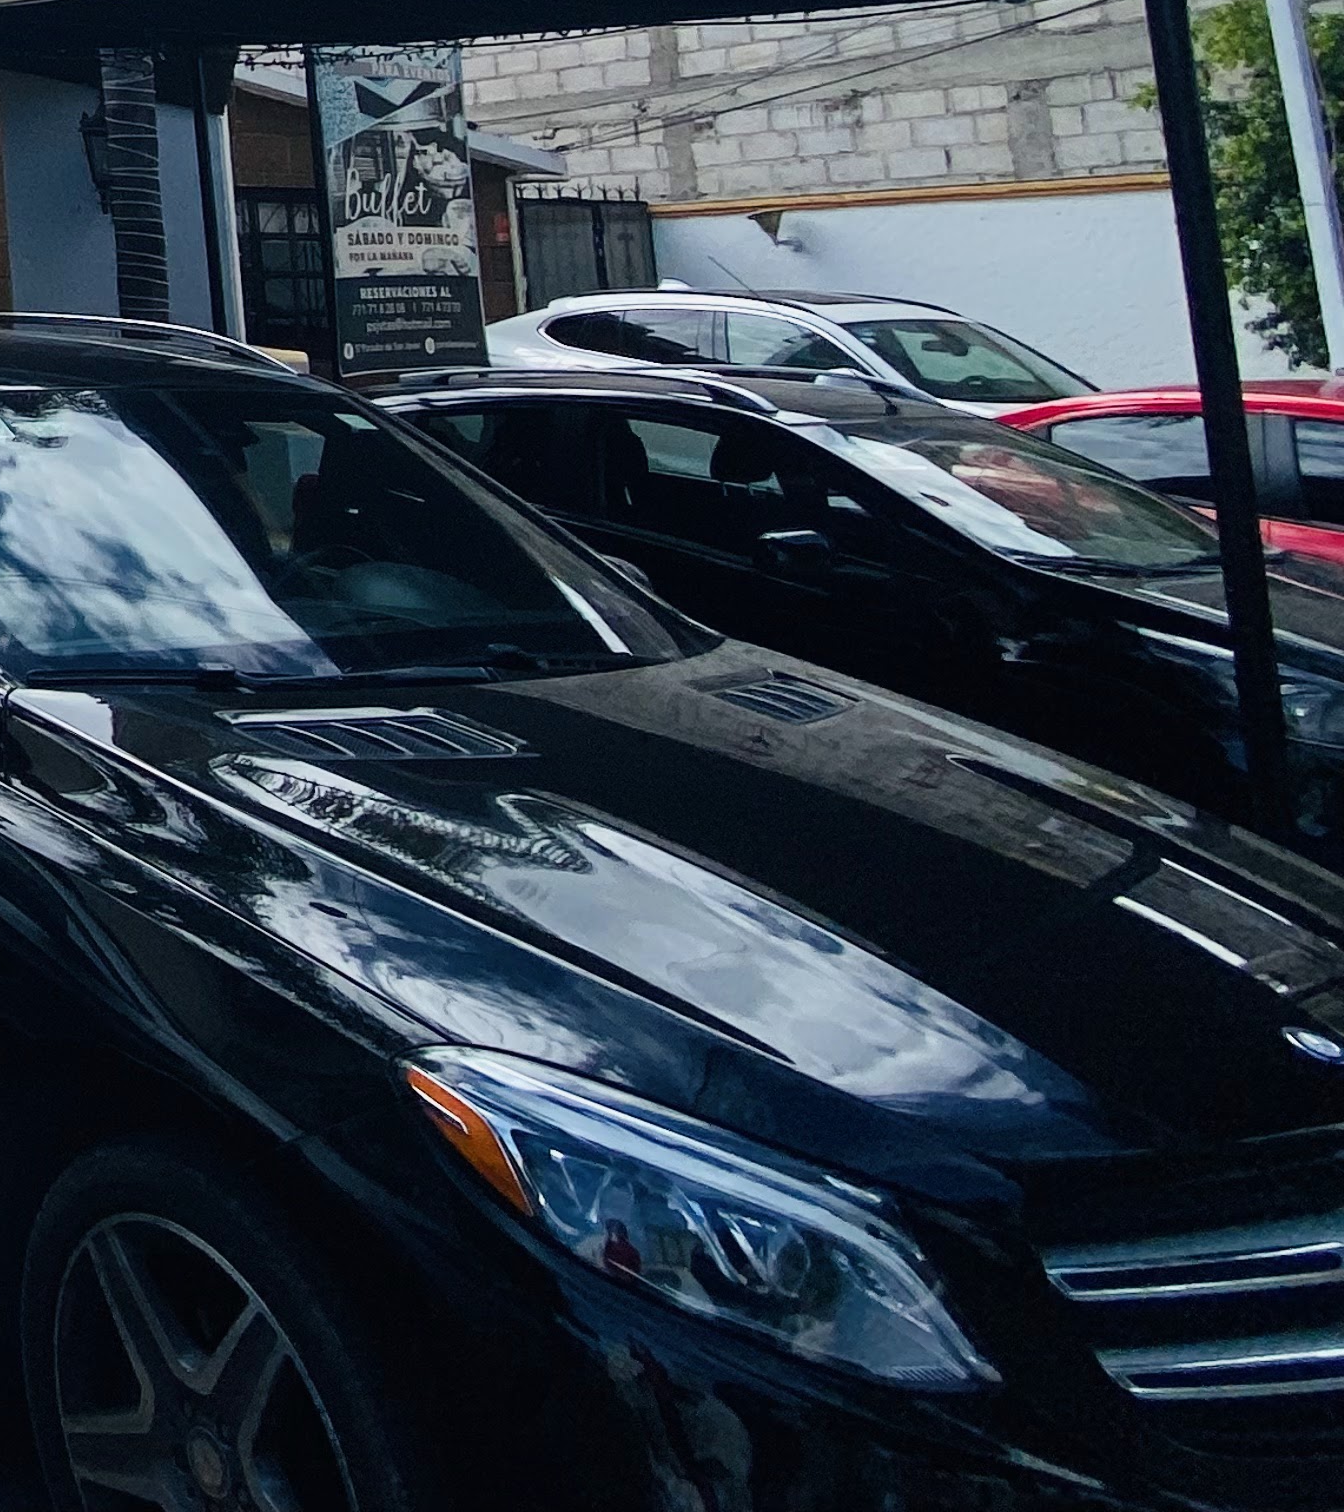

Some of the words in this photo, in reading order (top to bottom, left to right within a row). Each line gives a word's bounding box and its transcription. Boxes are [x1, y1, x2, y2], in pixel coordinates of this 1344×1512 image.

[345, 168, 432, 227] Buffet
[347, 230, 394, 246] SÁBADO
[397, 233, 405, 246] Y
[408, 233, 460, 246] DOMINGO
[360, 286, 437, 299] RESERVACIONES
[440, 286, 452, 298] AL
